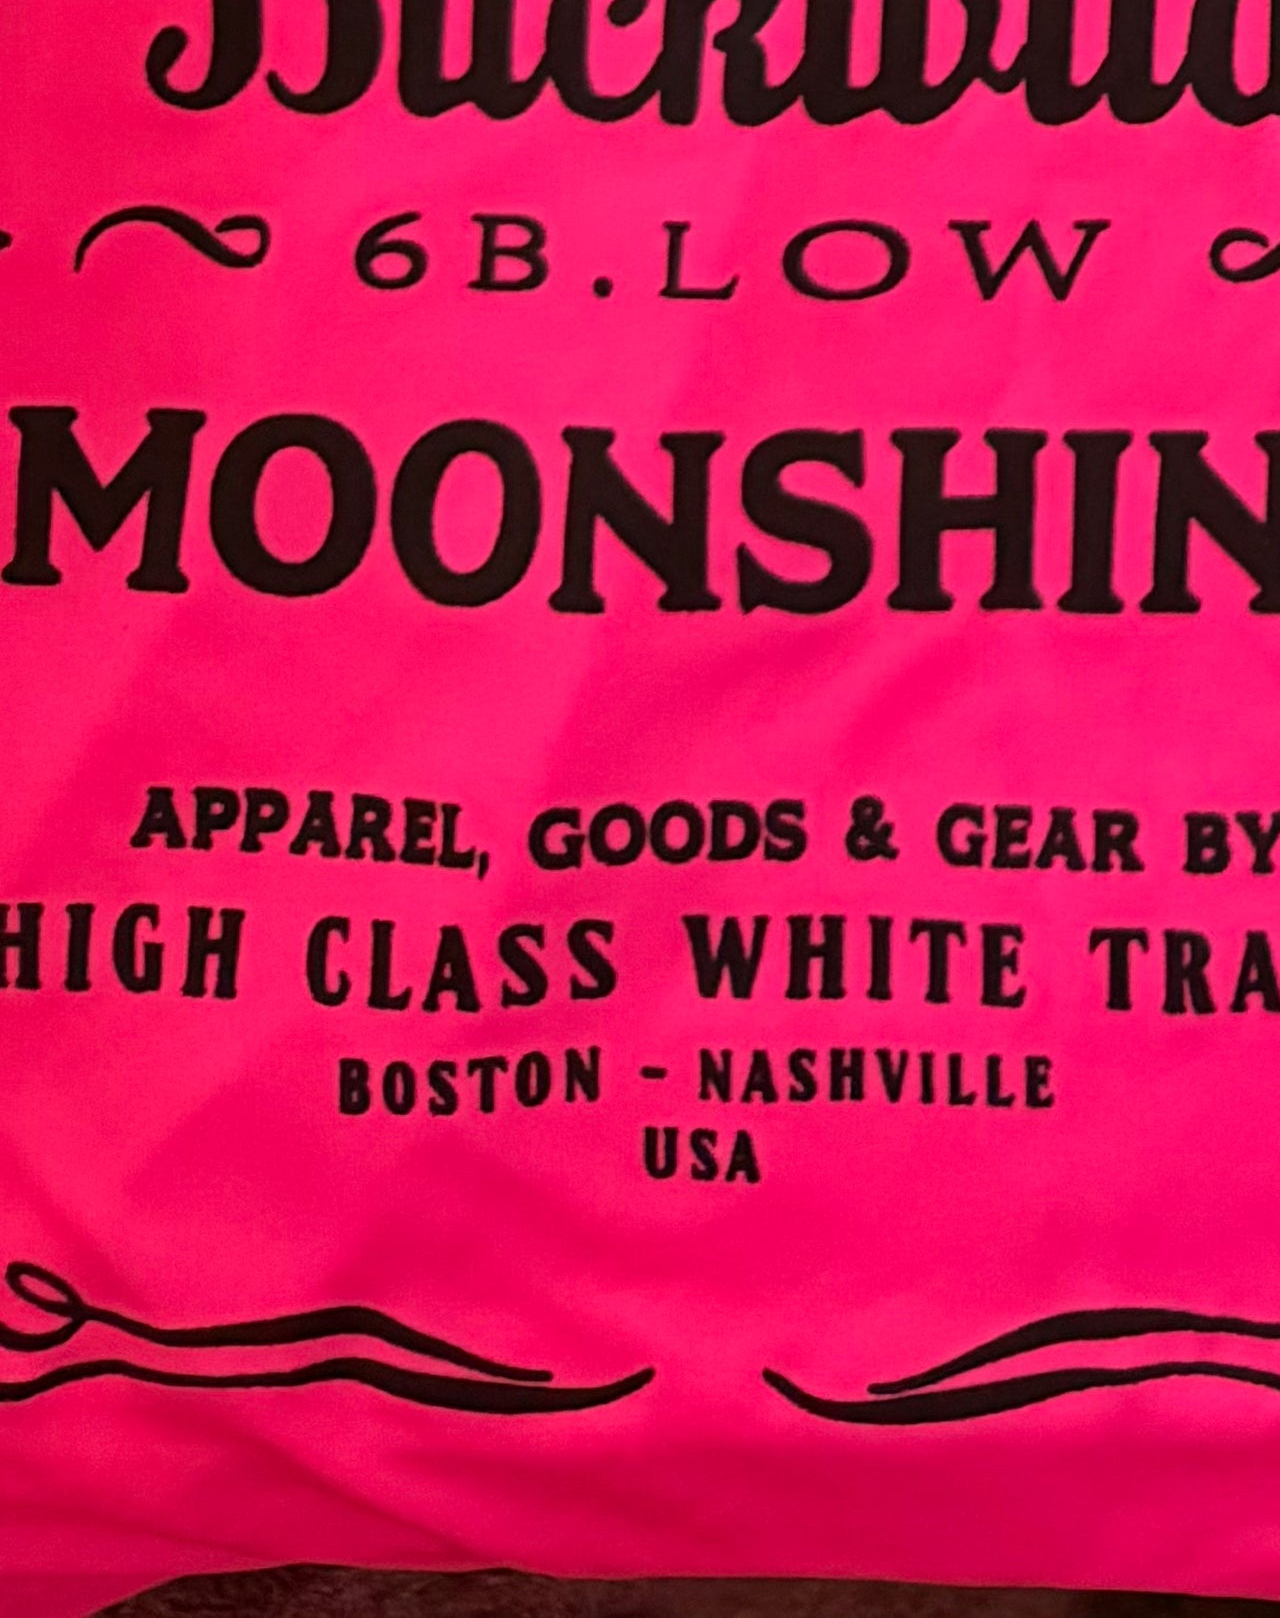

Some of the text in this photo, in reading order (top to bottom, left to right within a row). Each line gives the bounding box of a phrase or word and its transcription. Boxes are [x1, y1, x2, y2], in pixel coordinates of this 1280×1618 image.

[355, 213, 1109, 301] 6B.LOW
[130, 787, 488, 878] APPAREL,
[528, 800, 806, 870] GOODS
[845, 797, 898, 861] &
[937, 804, 1143, 872] GEAR
[0, 903, 244, 999] HIGH
[307, 917, 616, 1013] CLASS
[682, 915, 1025, 1008] WHITE
[340, 1047, 599, 1115] BOSTON
[700, 1049, 1053, 1108] NASHVILLE
[644, 1127, 760, 1183] USA
